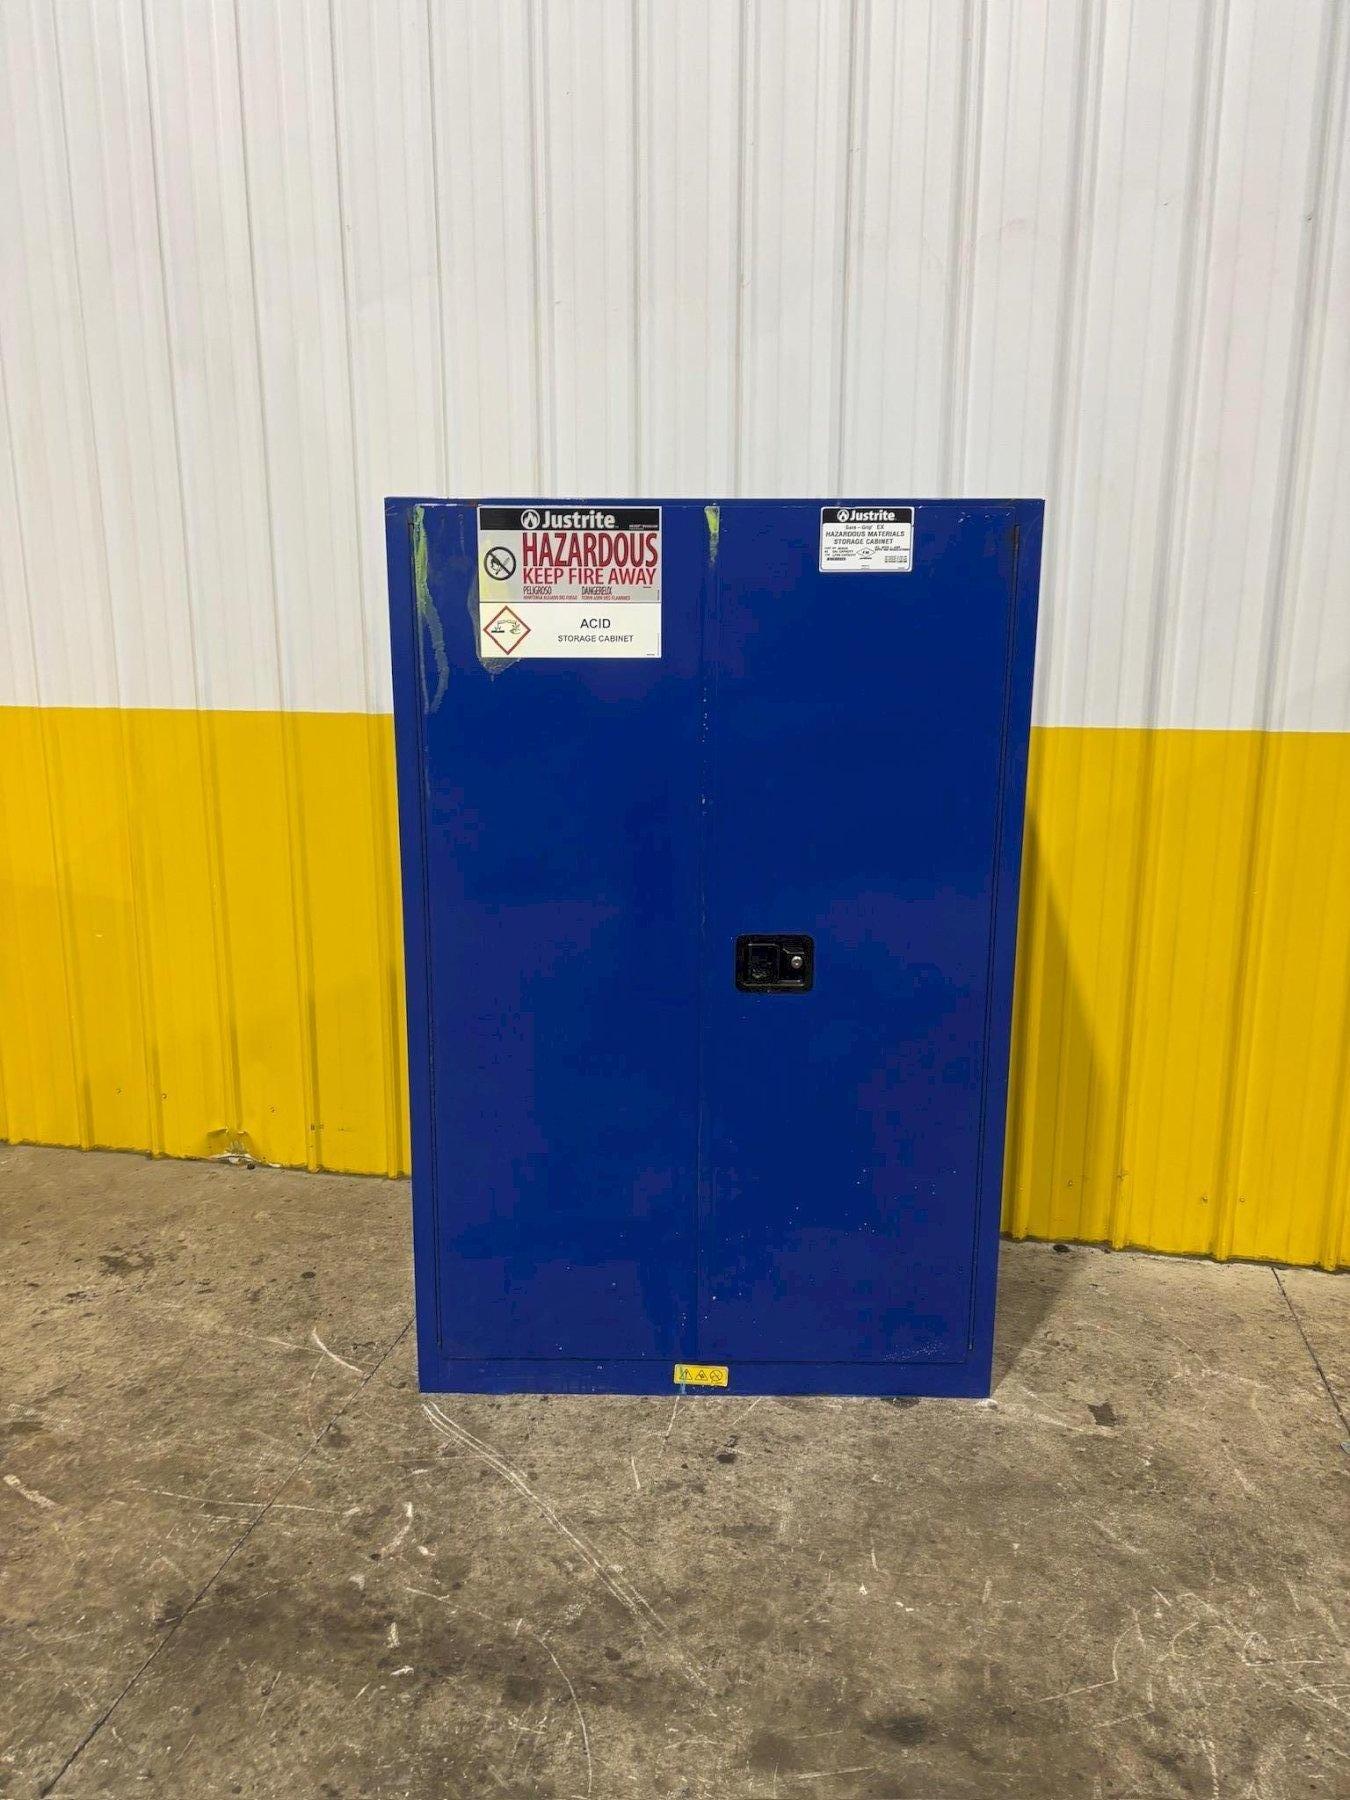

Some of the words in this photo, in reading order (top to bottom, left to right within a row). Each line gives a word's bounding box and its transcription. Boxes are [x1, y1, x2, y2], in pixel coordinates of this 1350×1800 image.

[542, 510, 616, 529] Justrite
[849, 510, 896, 521] Justrite
[522, 532, 658, 567] HAZARDOUS
[522, 568, 564, 585] KEEP
[568, 568, 604, 585] FIRE
[607, 568, 657, 585] AWAY
[523, 585, 552, 595] PELIGROSO
[581, 586, 613, 596] DANGEREUX
[580, 618, 611, 629] ACID
[558, 635, 597, 643] STORAGE
[598, 635, 634, 643] CABINET
